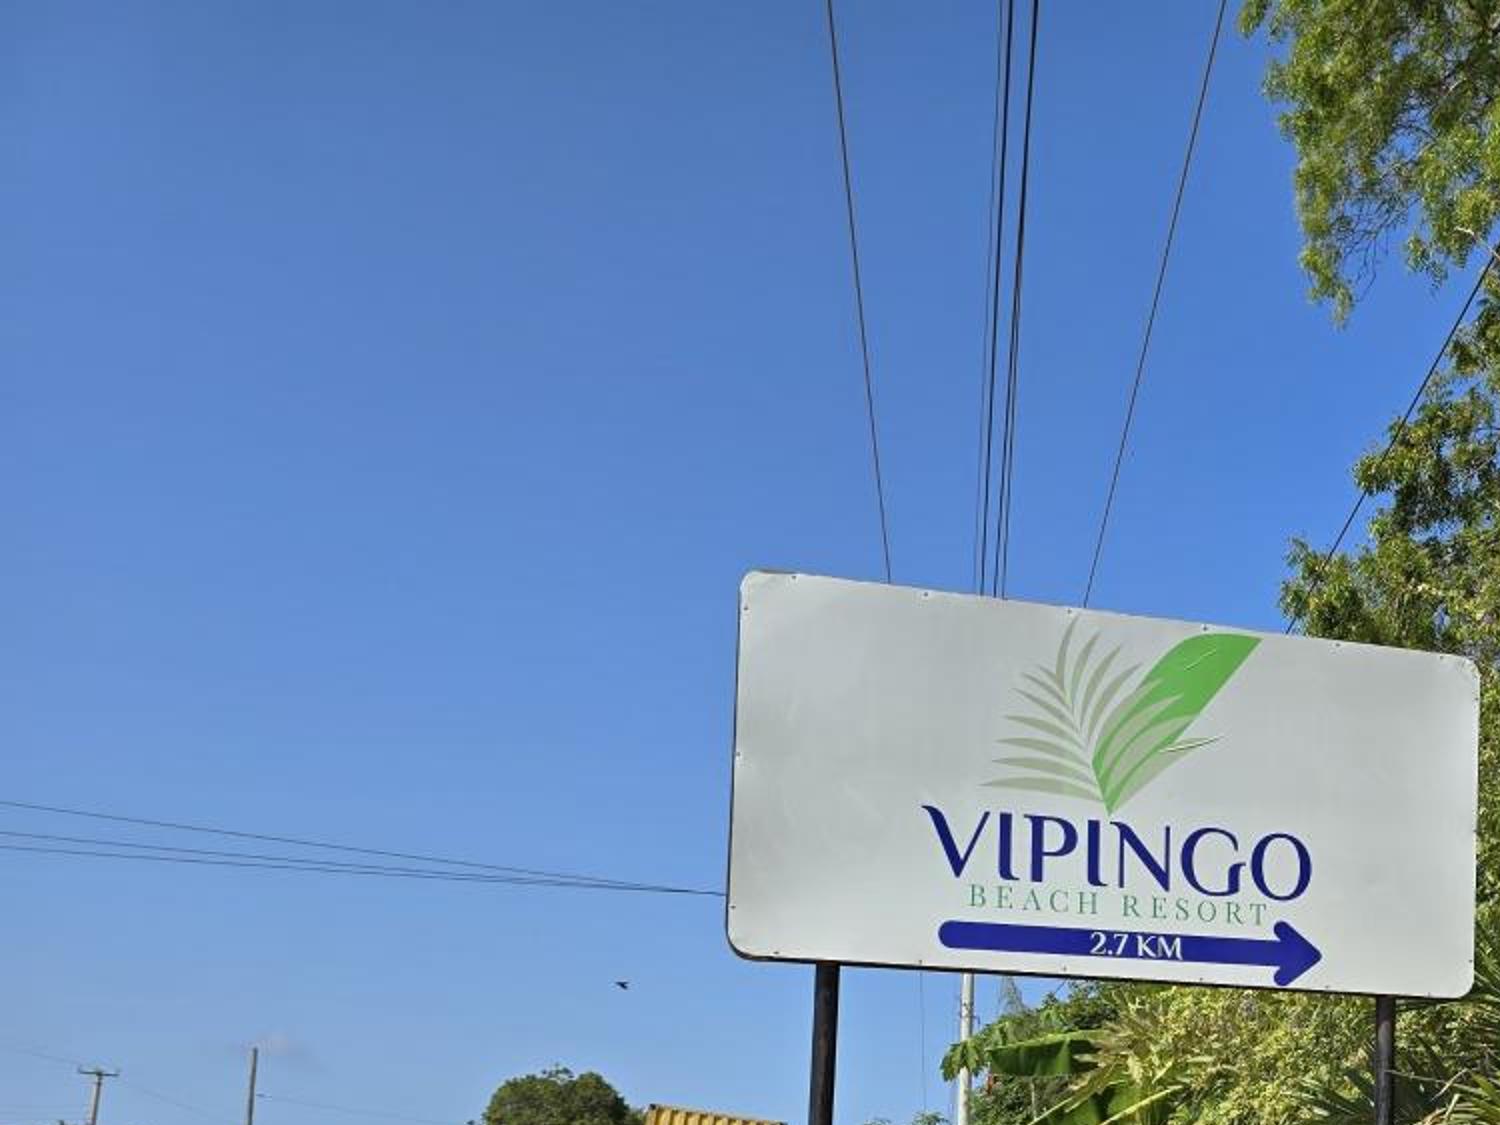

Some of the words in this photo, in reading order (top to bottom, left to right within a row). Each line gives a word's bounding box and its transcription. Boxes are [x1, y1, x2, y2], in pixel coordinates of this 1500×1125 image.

[921, 805, 1313, 901] VIPINGO
[968, 884, 1098, 916] BEACH
[1123, 896, 1267, 926] RESORT
[1089, 931, 1128, 957] 2.7
[1137, 935, 1184, 961] KM
